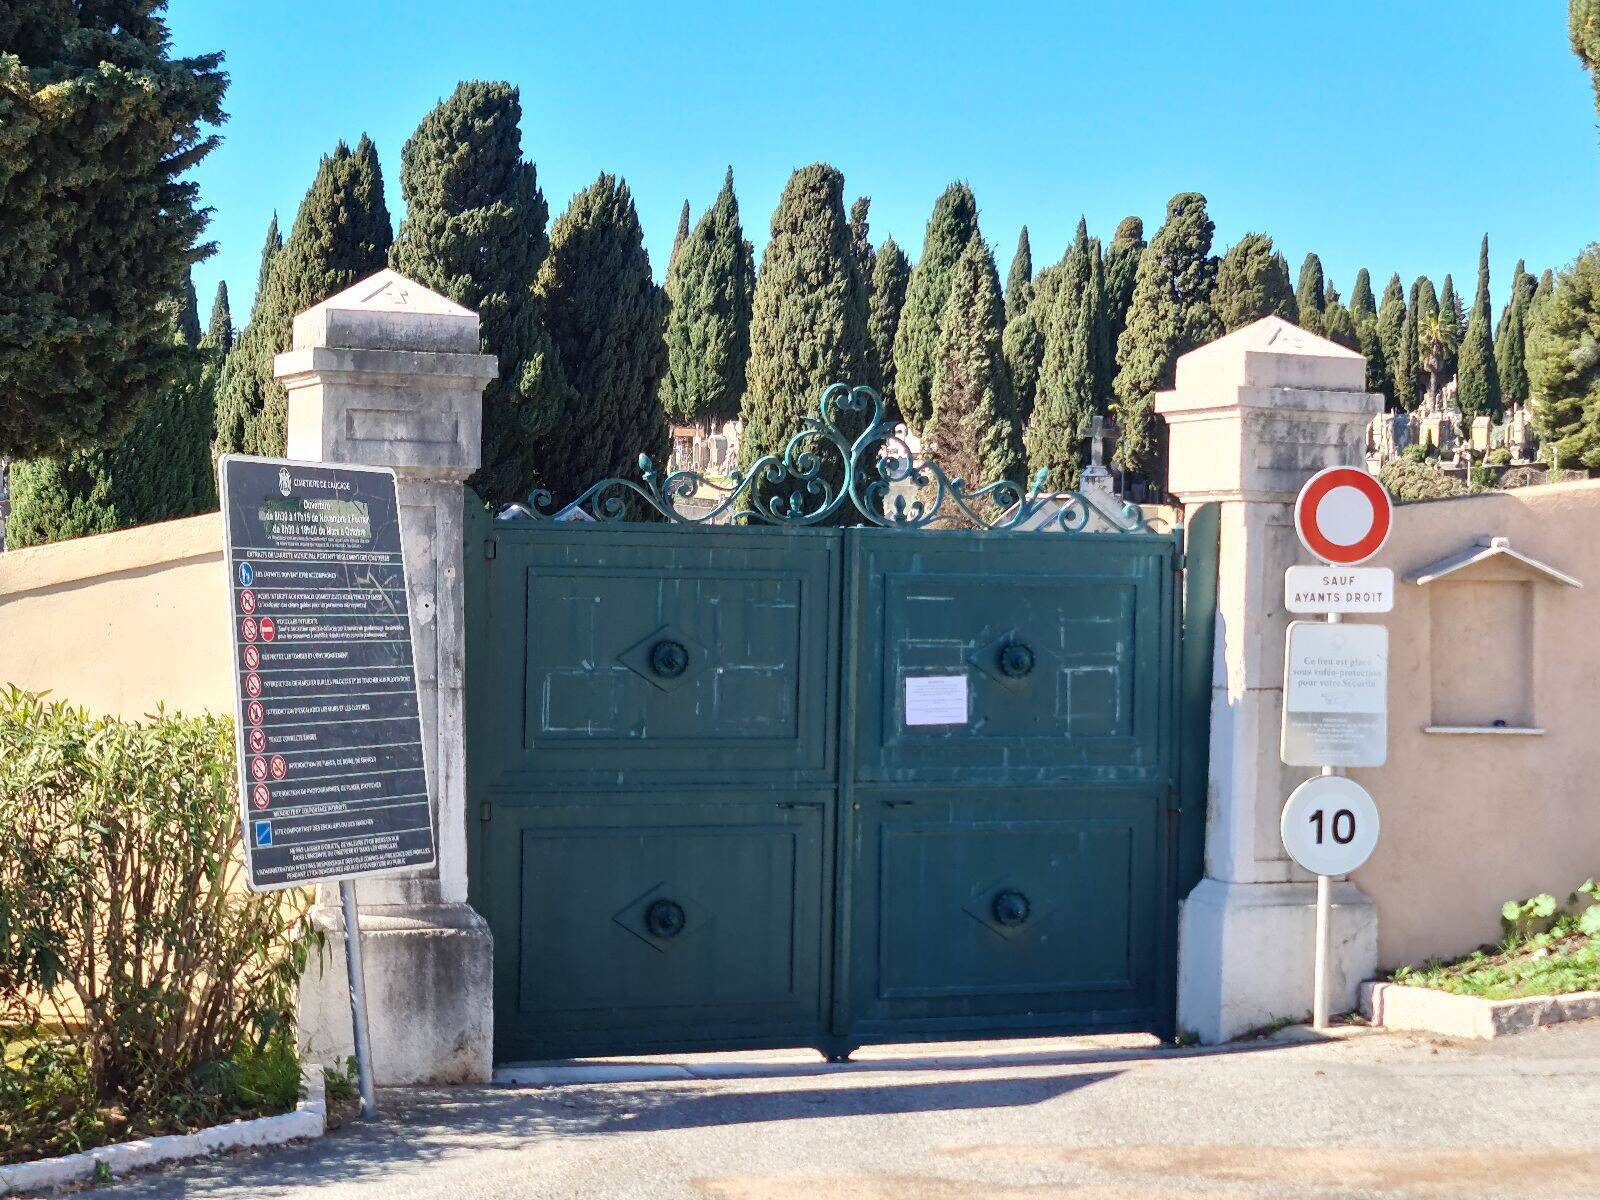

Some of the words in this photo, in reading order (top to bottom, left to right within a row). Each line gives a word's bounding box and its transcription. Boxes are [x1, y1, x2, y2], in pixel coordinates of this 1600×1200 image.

[1322, 576, 1356, 586] SAUF
[1294, 592, 1341, 602] AYANTS
[1346, 592, 1383, 602] DROIT
[1304, 656, 1316, 666] Ce
[1318, 656, 1333, 666] lieu
[1336, 658, 1348, 666] est
[1308, 808, 1356, 844] 10
